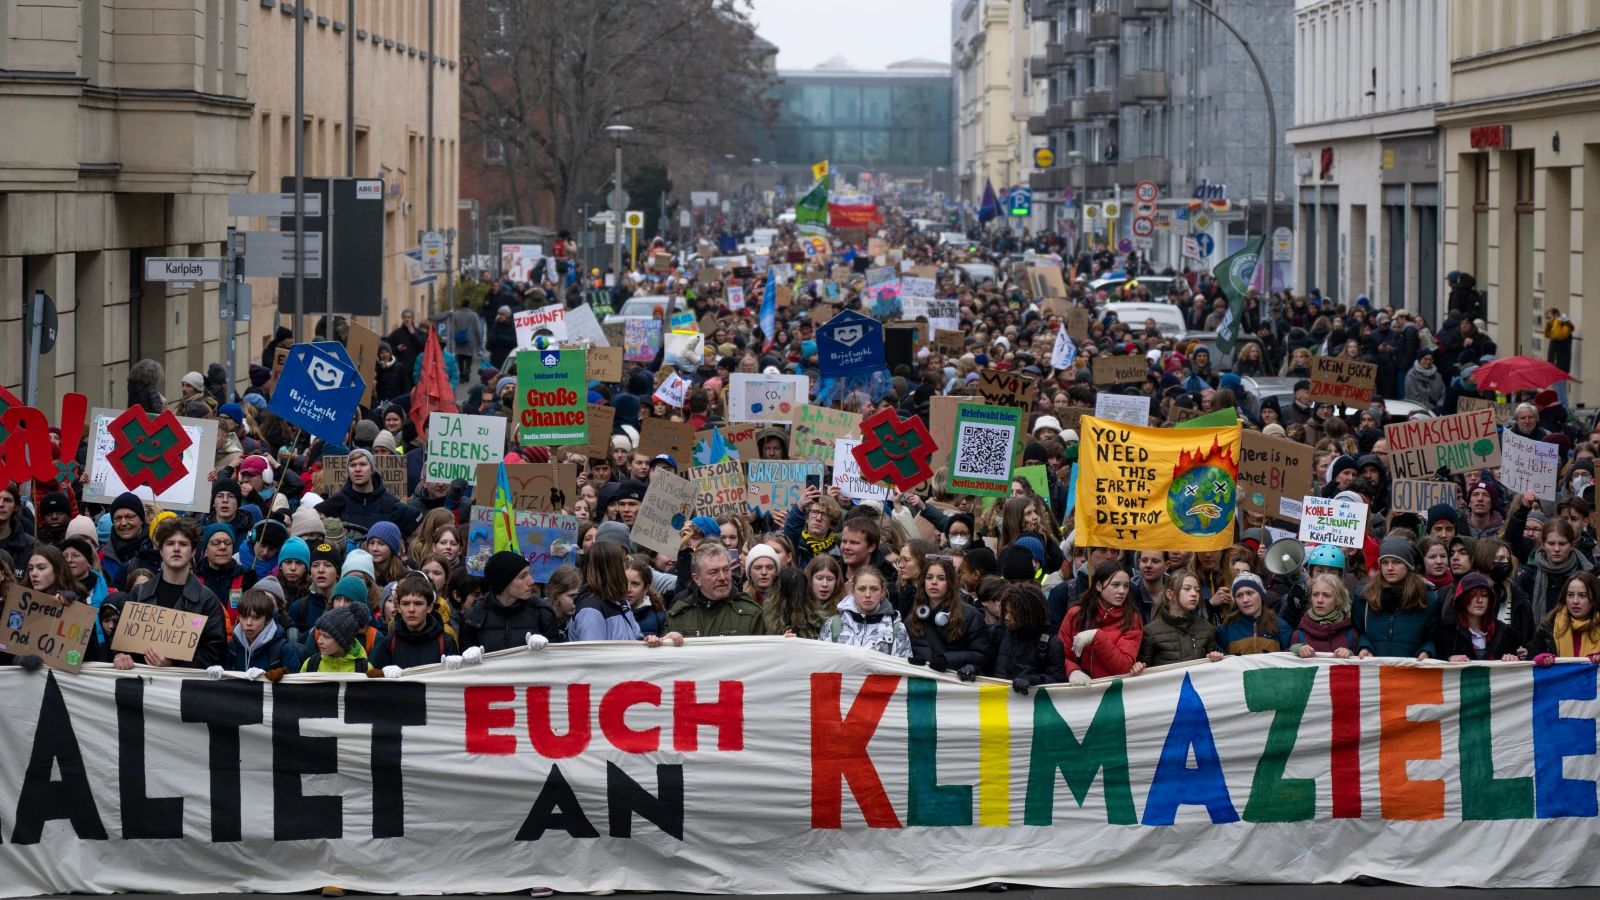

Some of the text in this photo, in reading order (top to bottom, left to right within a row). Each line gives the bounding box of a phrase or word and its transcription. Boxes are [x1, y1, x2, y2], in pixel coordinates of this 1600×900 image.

[1140, 186, 1154, 198] 30
[1195, 178, 1225, 199] dm
[1152, 213, 1169, 222] dm
[165, 262, 203, 276] Karlplatz
[515, 307, 564, 329] ZUKUNFT
[1115, 366, 1146, 380] Insekten
[1348, 363, 1374, 380] BOCK
[526, 386, 578, 407] Große
[520, 409, 585, 427] Chance
[961, 408, 999, 421] Briefwahl
[438, 415, 463, 438] JA
[1091, 426, 1131, 443] YOU
[1387, 409, 1497, 451] KLIMASCHUTZ
[539, 432, 551, 440] 2030
[430, 439, 499, 462] LEBENS-
[1096, 443, 1149, 462] NEED
[1270, 448, 1281, 463] is
[1285, 454, 1300, 467] no
[715, 461, 739, 477] OUR
[1392, 442, 1475, 479] WEIL BAUM
[748, 462, 779, 485] GANZ
[834, 473, 849, 486] NO
[1118, 465, 1157, 481] THIS
[1238, 468, 1267, 486] anet
[1501, 464, 1552, 495] Mutter
[951, 478, 1008, 493] berlin2030.org
[1096, 478, 1151, 495] EARTH,
[696, 493, 714, 506] SO
[716, 487, 745, 505] STOP
[770, 485, 801, 508] EIS
[1096, 495, 1149, 509] SO DON'T
[1393, 481, 1458, 512] GO VEGAN
[739, 500, 748, 514] IT
[1304, 505, 1334, 517] KOHLE
[513, 511, 559, 530] LASTIK
[1096, 510, 1163, 526] DESTROY
[1316, 516, 1361, 531] ZUKUNFT
[1116, 528, 1139, 540] IT
[1309, 531, 1356, 546] KRAFTWERK
[18, 591, 65, 619] Spread
[128, 602, 187, 629] THERE IS
[9, 631, 30, 646] not
[56, 619, 91, 646] LOVE
[123, 621, 199, 649] NO PLANET B
[0, 667, 745, 844] ALTET EUCH
[810, 664, 1600, 829] KLIMAZIELE
[514, 759, 684, 842] AN
